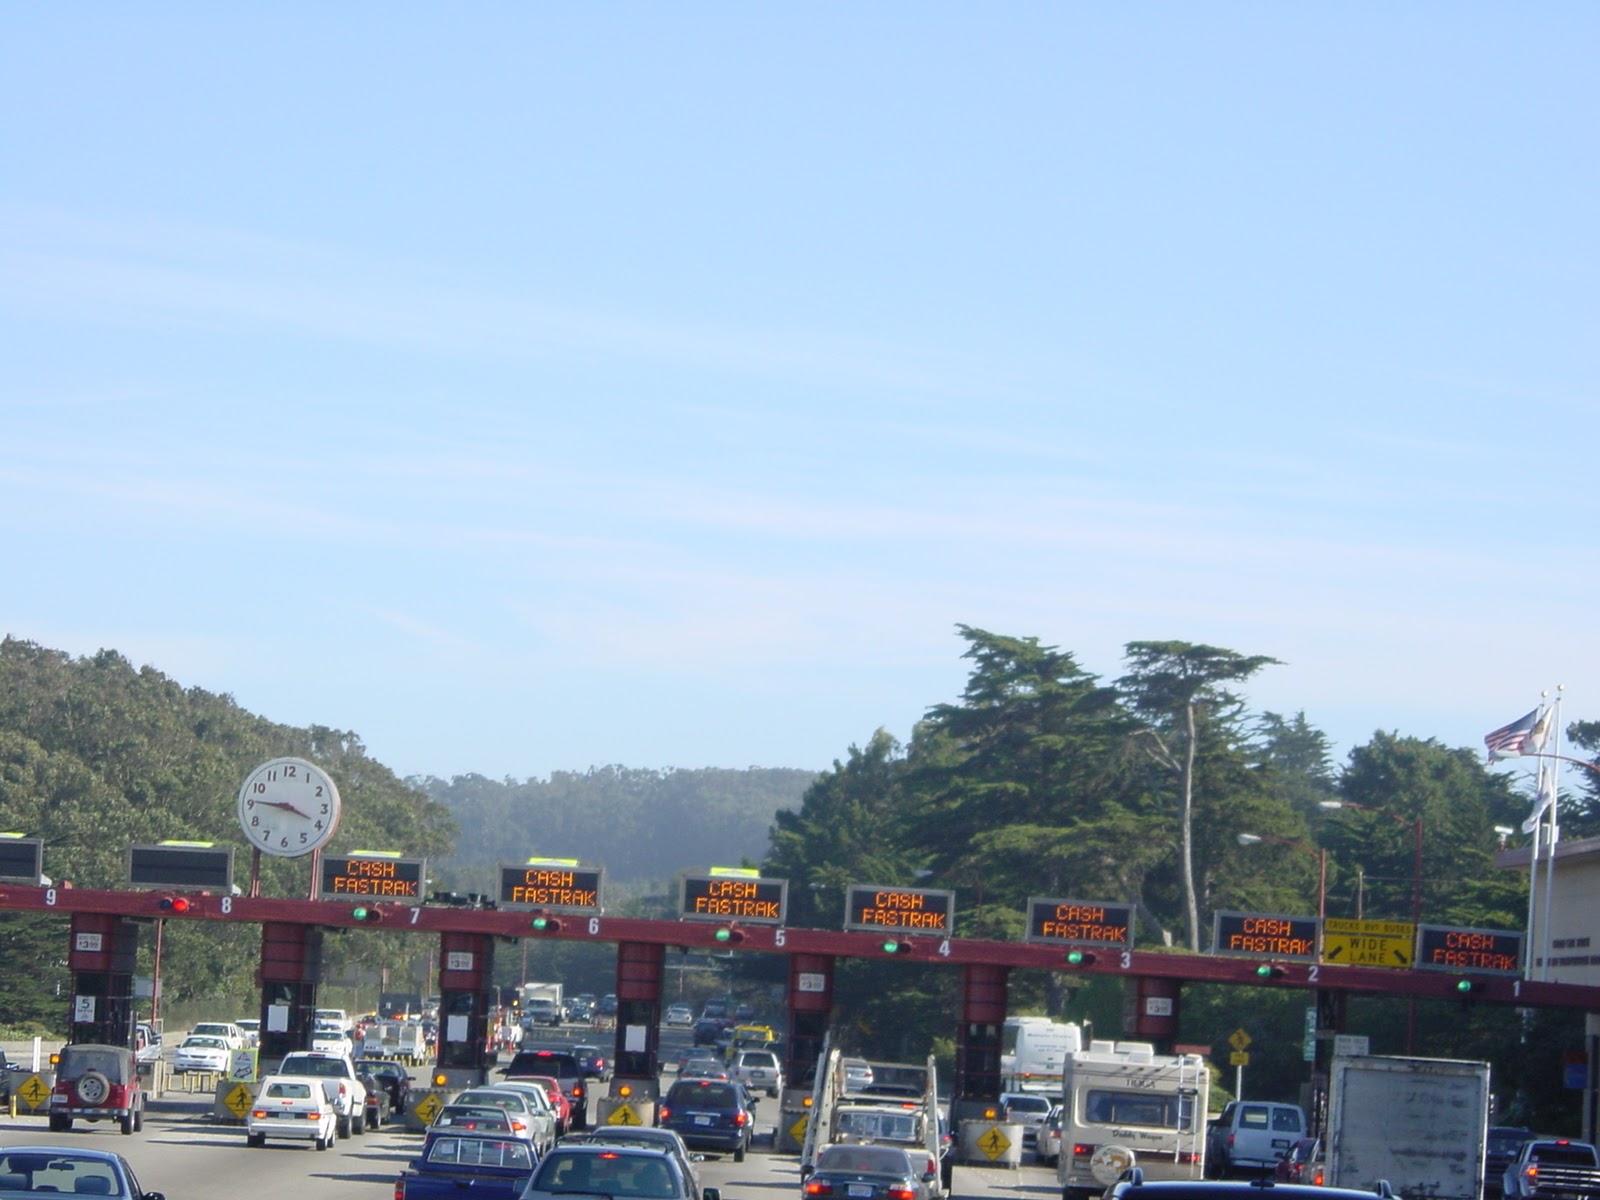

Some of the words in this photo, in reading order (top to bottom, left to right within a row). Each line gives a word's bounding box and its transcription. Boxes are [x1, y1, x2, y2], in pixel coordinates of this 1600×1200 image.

[267, 770, 277, 782] 11
[283, 765, 297, 778] 12
[306, 772, 310, 784] 1
[253, 782, 266, 794] 10
[315, 785, 323, 798] 2
[247, 799, 255, 811] 9
[320, 803, 329, 815] 3
[251, 815, 259, 827] 8
[314, 819, 323, 832] 4
[263, 829, 271, 842] 7
[280, 836, 289, 849] 6
[299, 832, 308, 845] 5
[347, 860, 395, 877] CASH
[334, 877, 417, 896] FASTRAK
[525, 869, 574, 887] CASH
[46, 888, 57, 906] 9
[512, 886, 596, 907] FASTRAK
[708, 880, 758, 899] CASH
[221, 896, 232, 914] 8
[695, 897, 780, 918] FASTRAK
[875, 891, 924, 909] CASH
[411, 907, 421, 925] 7
[862, 908, 946, 929] FASTRAK
[1056, 904, 1104, 923] CASH
[589, 917, 600, 935] 6
[1042, 921, 1127, 942] FASTRAK
[1243, 917, 1292, 936] CASH
[1328, 920, 1359, 932] TRUCKS
[776, 929, 786, 947] 5
[1230, 934, 1314, 955] FASTRAK
[1350, 937, 1388, 951] WIDE
[1446, 932, 1495, 951] CASH
[939, 940, 951, 957] 4
[1350, 952, 1386, 963] LANE
[1121, 952, 1131, 970] 3
[1433, 949, 1518, 970] FASTRAK
[1308, 965, 1319, 982] 2
[1512, 979, 1521, 997] 1
[81, 998, 90, 1009] 5
